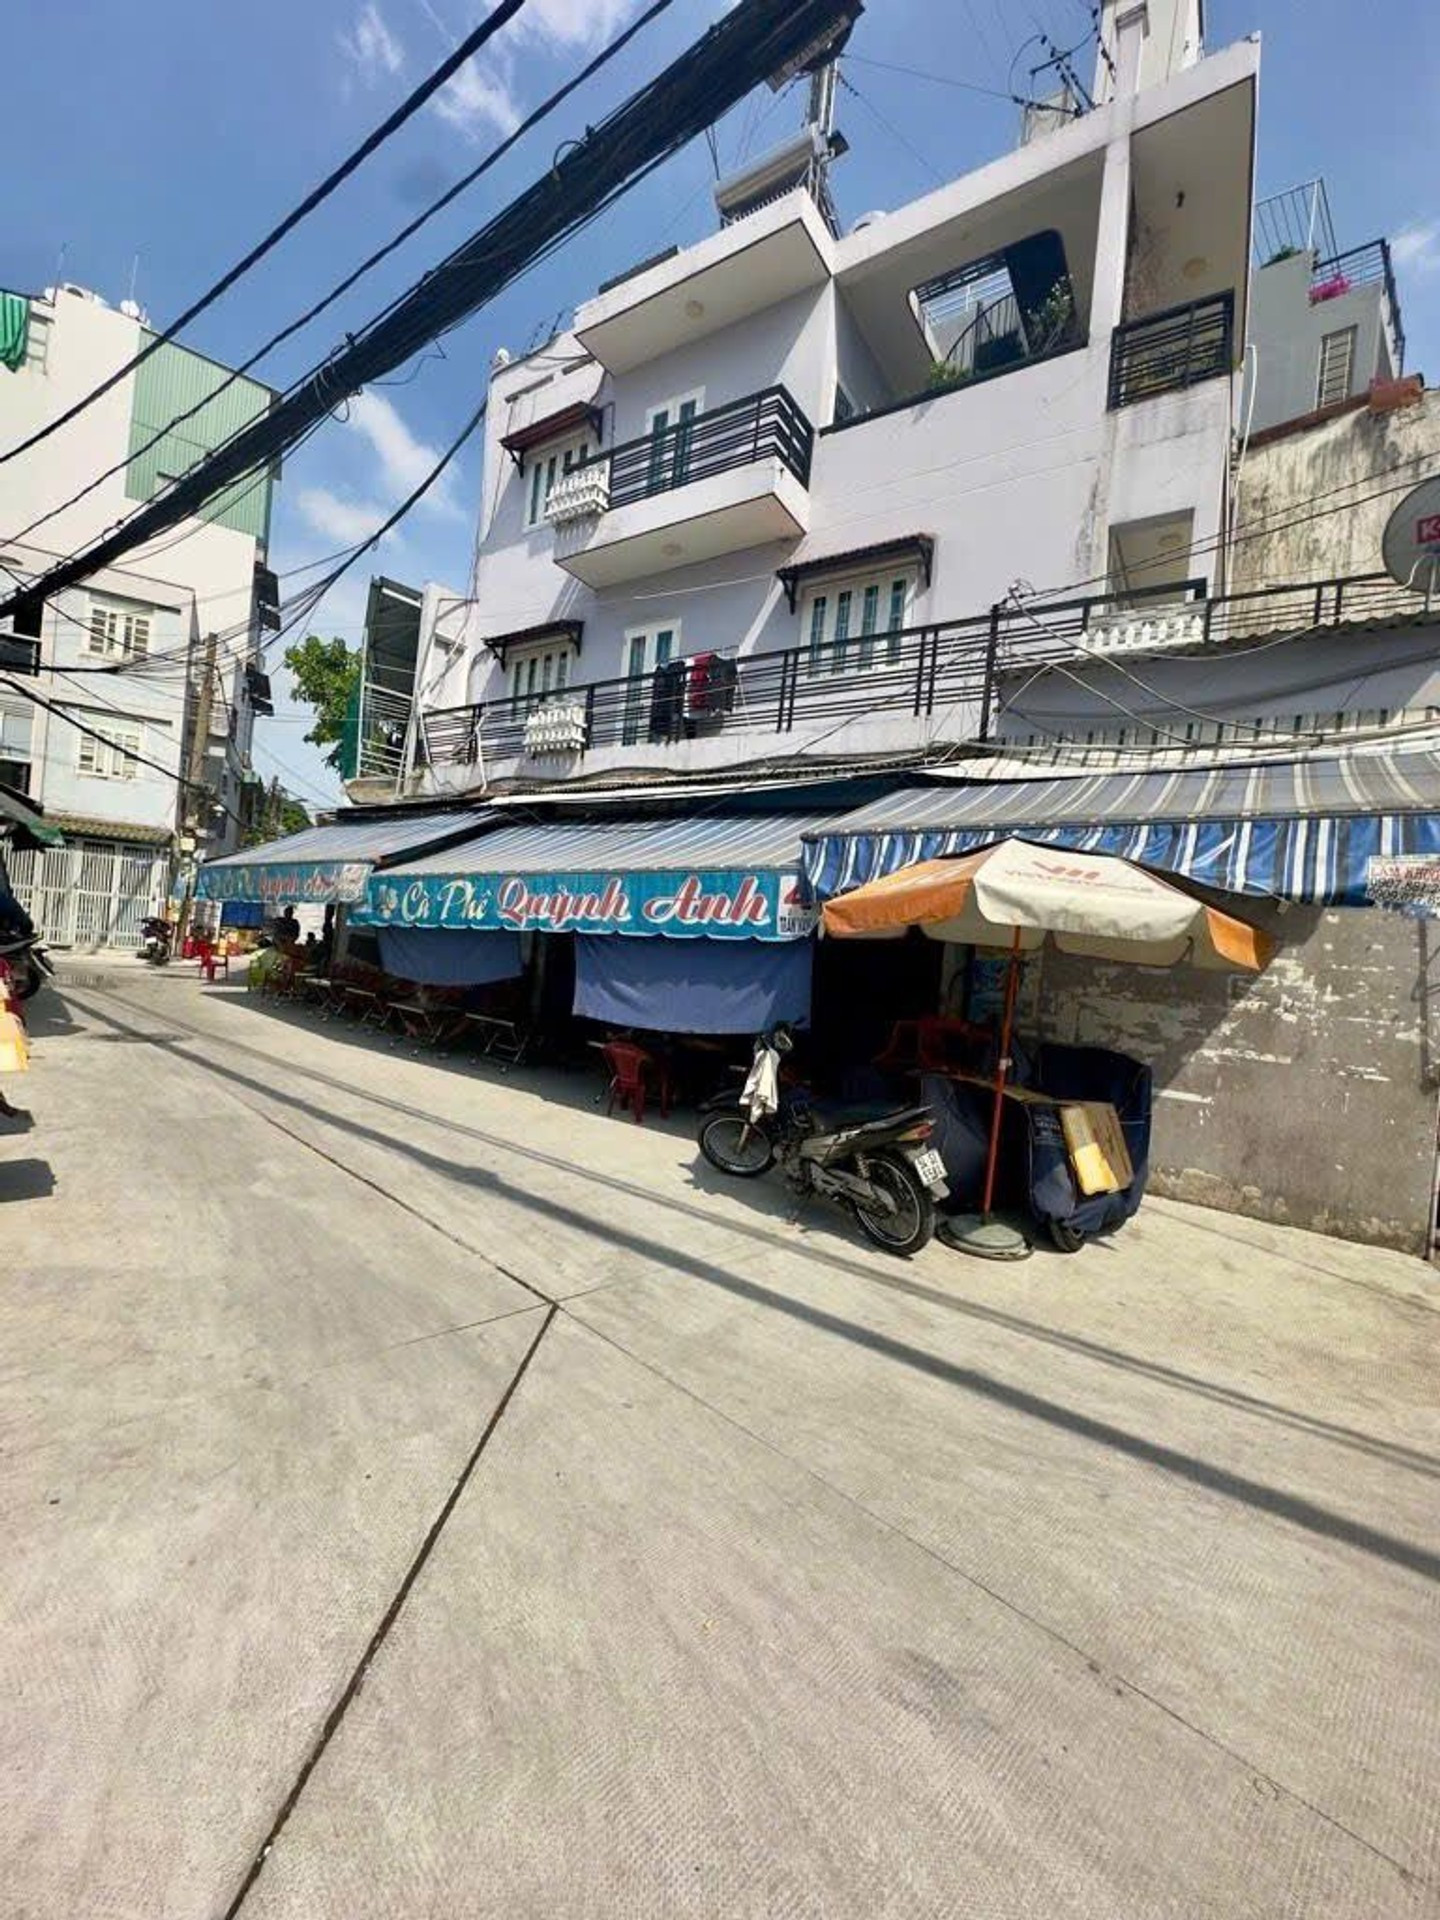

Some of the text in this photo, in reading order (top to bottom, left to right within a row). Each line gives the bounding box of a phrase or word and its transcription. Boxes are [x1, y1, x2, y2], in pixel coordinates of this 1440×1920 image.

[402, 881, 430, 921] Cà
[437, 880, 492, 920] Phê
[498, 877, 632, 928] Quỳnh
[643, 875, 771, 925] Anh
